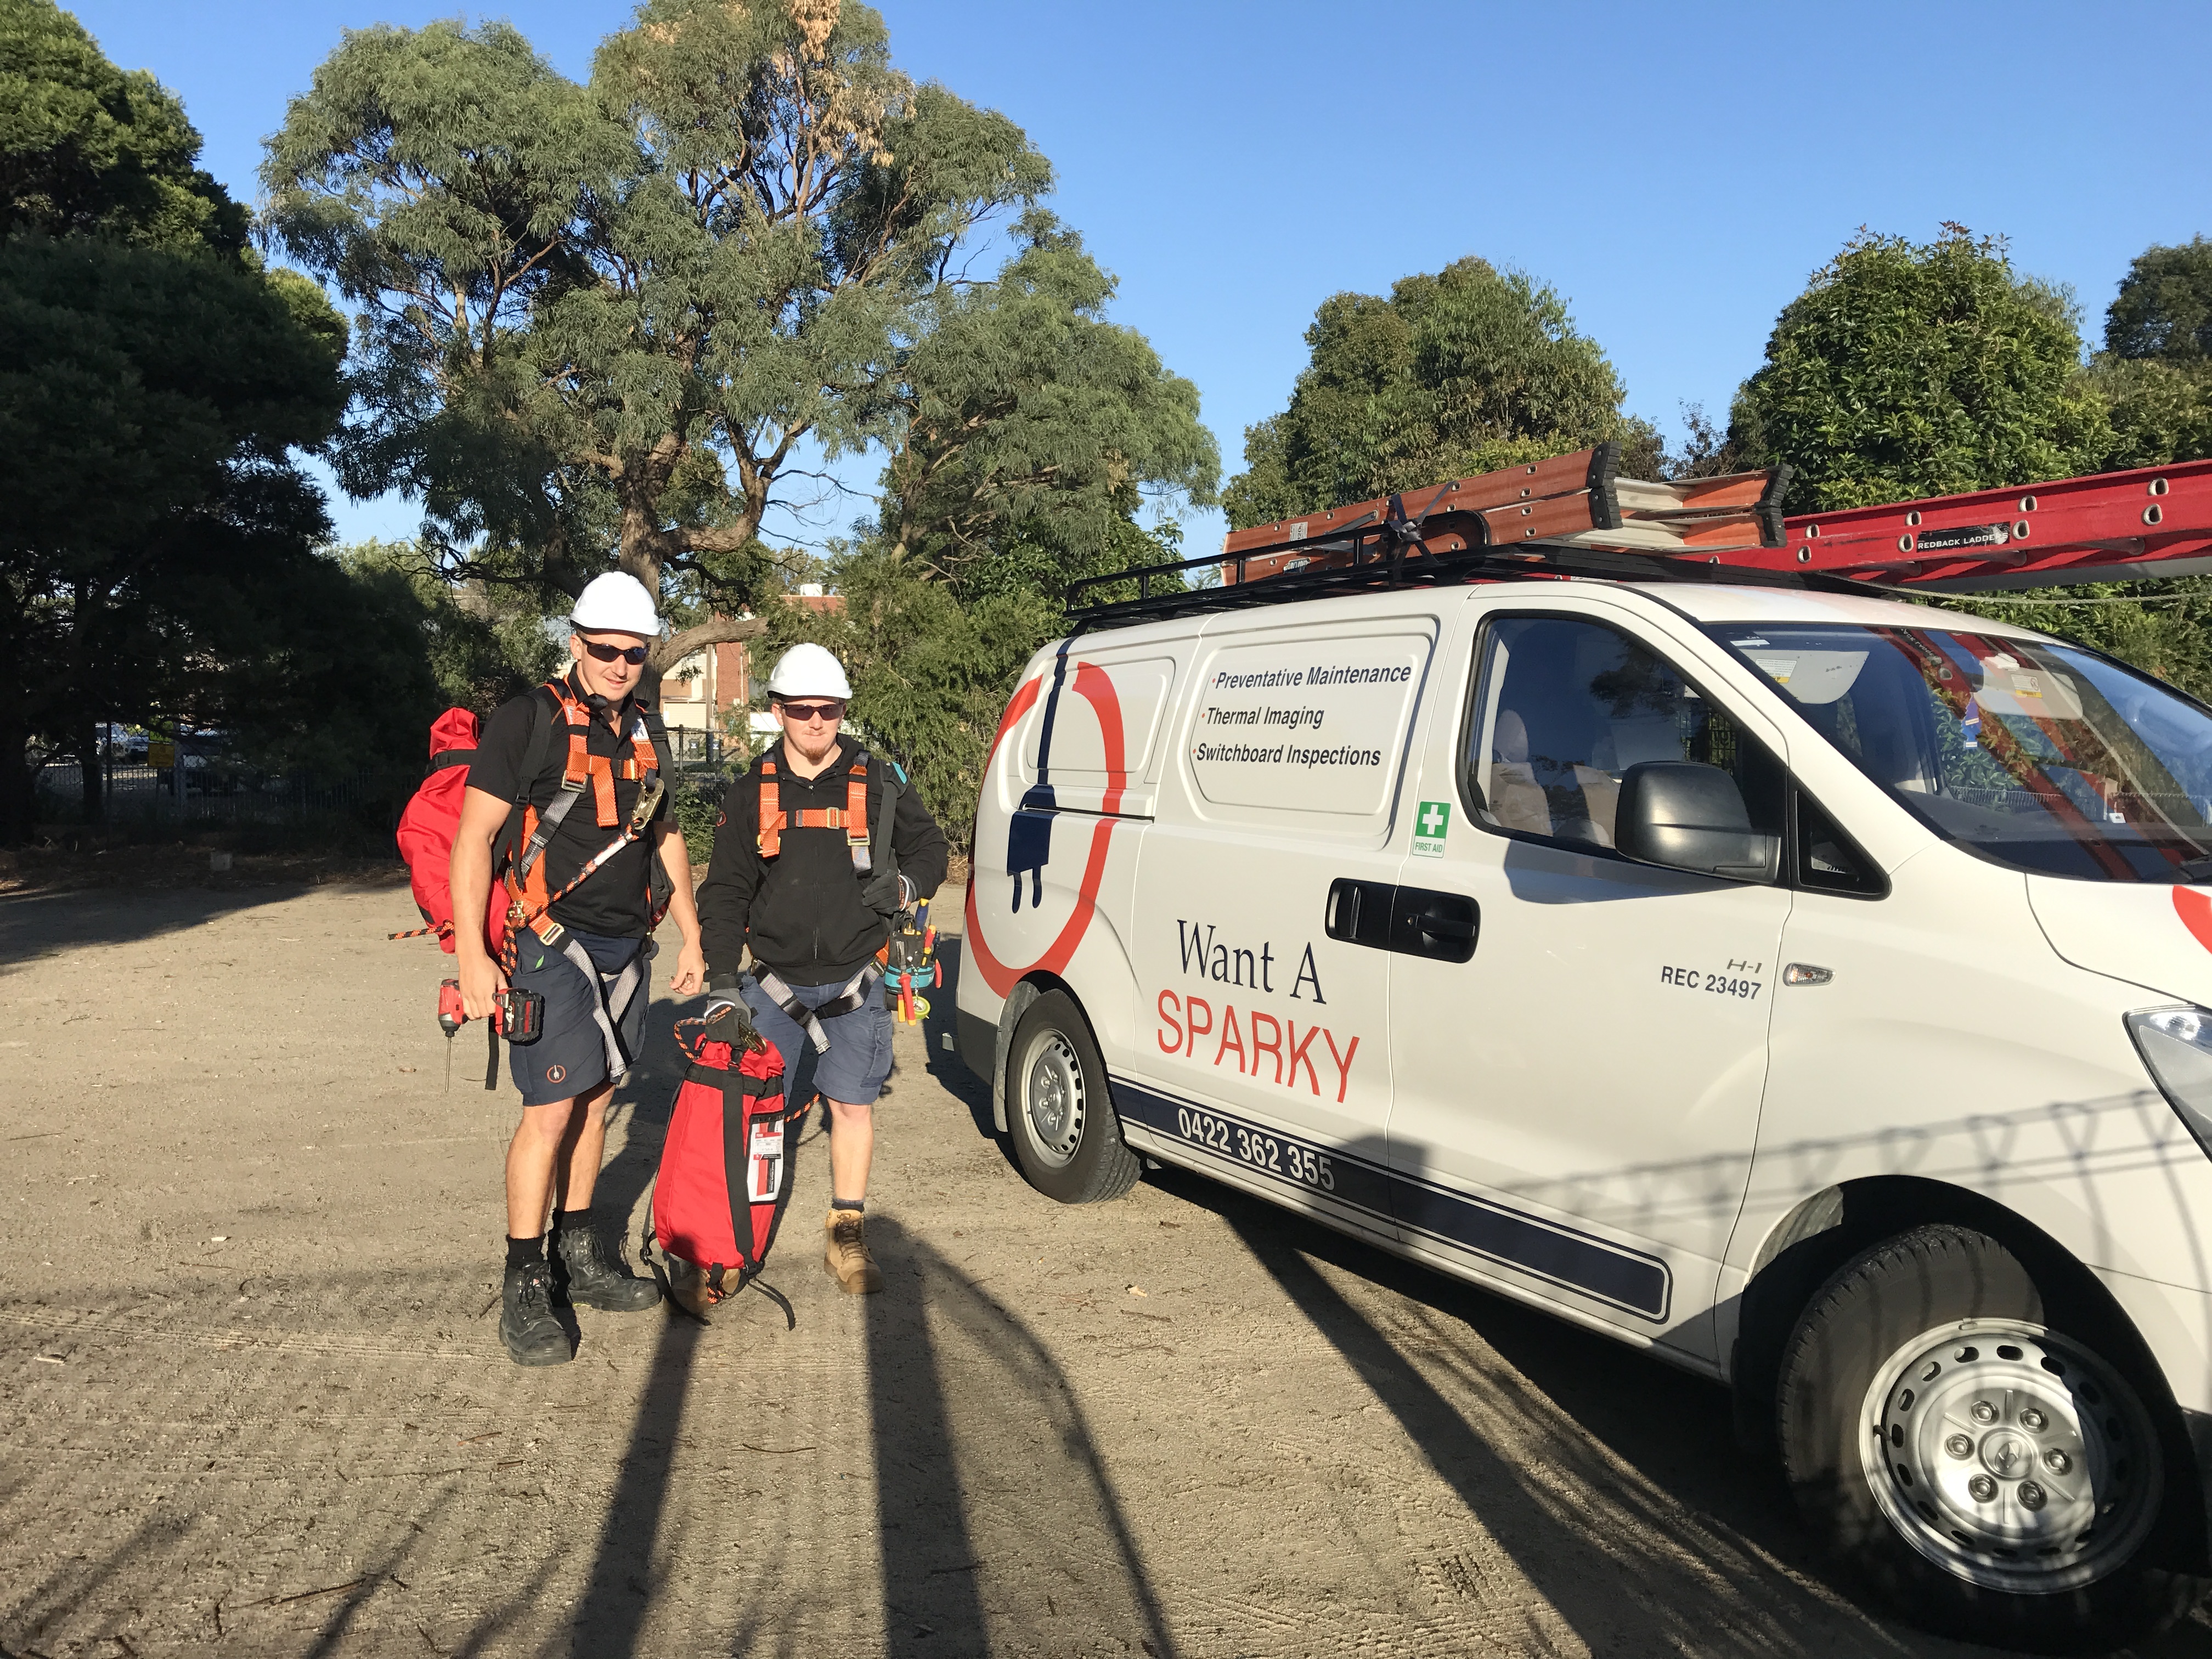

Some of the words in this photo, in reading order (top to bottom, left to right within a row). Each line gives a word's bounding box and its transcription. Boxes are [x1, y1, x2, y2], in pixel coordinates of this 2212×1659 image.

[1918, 539, 1961, 549] REDBACK
[1964, 532, 2008, 544] LADDERS
[1215, 668, 1302, 689] Preventative
[1306, 666, 1411, 685] Maintenance
[1207, 707, 1261, 725] Thermal
[1263, 706, 1324, 729] Imaging
[1197, 743, 1284, 763] Switchboard
[1286, 745, 1381, 769] Inspections
[1415, 842, 1431, 851] FIRST
[1432, 844, 1443, 853] AID
[1177, 919, 1274, 992] Want
[1290, 942, 1327, 1005] A
[1726, 959, 1762, 974] H-1
[1661, 966, 1700, 989] REC
[1705, 974, 1762, 1000] 23497
[1158, 989, 1360, 1103] SPARKY
[1178, 1108, 1232, 1153] 0422
[1238, 1128, 1283, 1172] 362
[1288, 1146, 1335, 1190] 355
